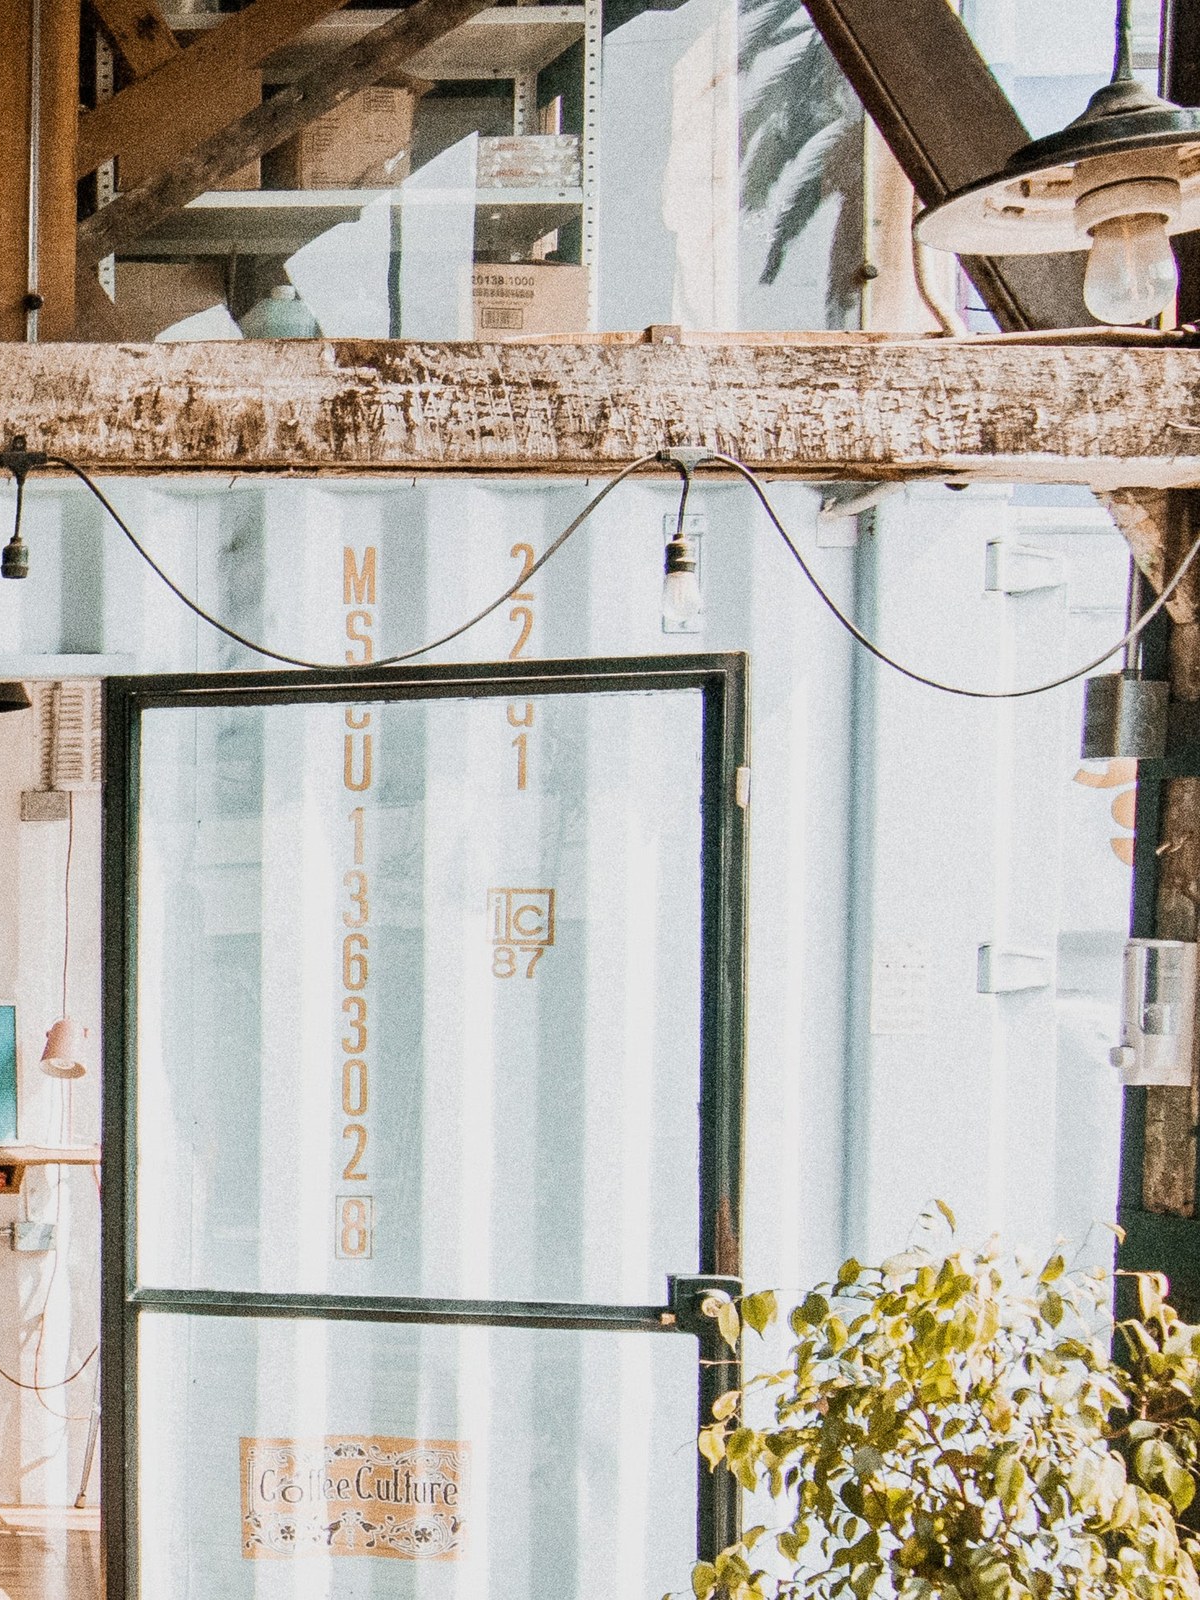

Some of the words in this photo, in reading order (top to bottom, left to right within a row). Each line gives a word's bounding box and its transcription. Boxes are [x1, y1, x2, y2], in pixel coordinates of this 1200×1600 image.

[492, 946, 545, 979] 87
[259, 1468, 351, 1504] Coffee
[354, 1465, 459, 1506] Culture
